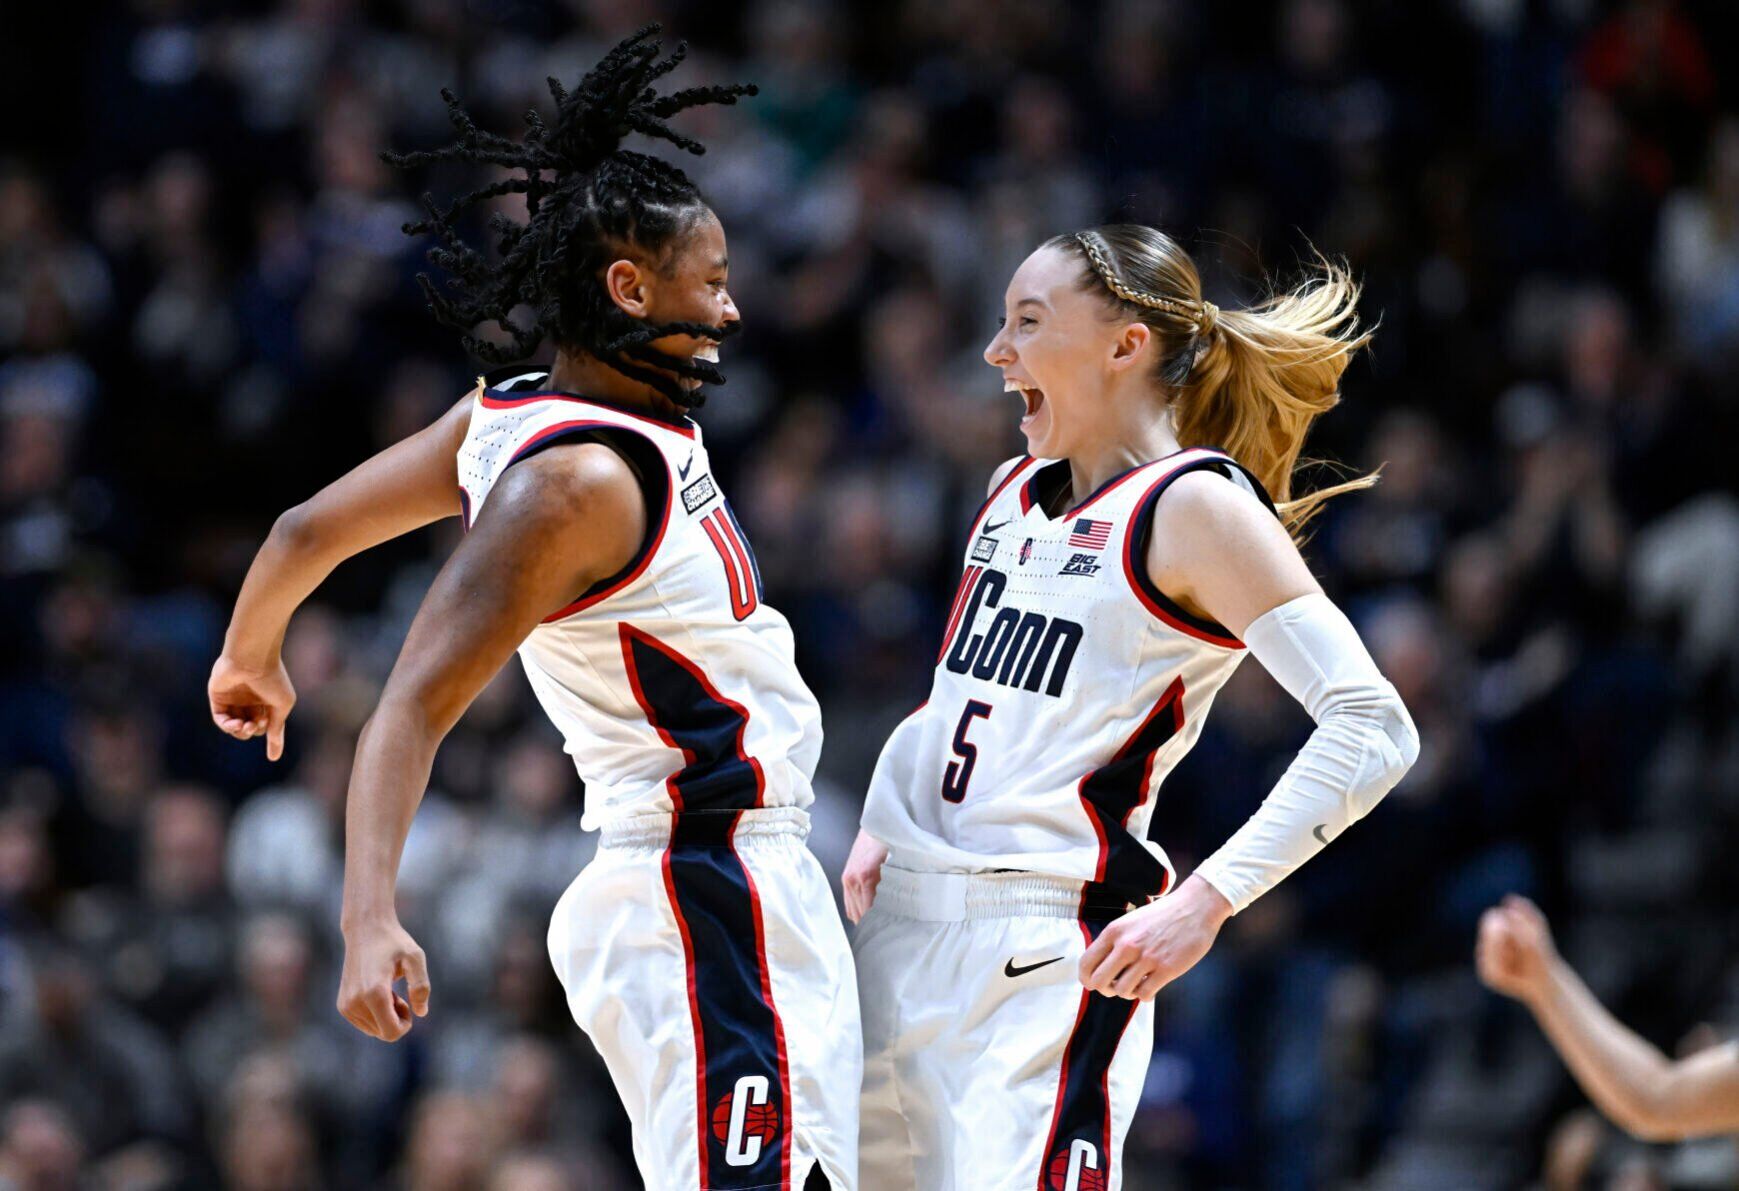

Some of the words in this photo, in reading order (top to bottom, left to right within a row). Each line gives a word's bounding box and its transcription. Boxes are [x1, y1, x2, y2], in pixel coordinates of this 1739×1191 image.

[700, 499, 763, 621] U
[1063, 562, 1102, 574] EAST
[1070, 553, 1098, 565] BIG
[942, 699, 993, 804] 5
[725, 1076, 769, 1167] C
